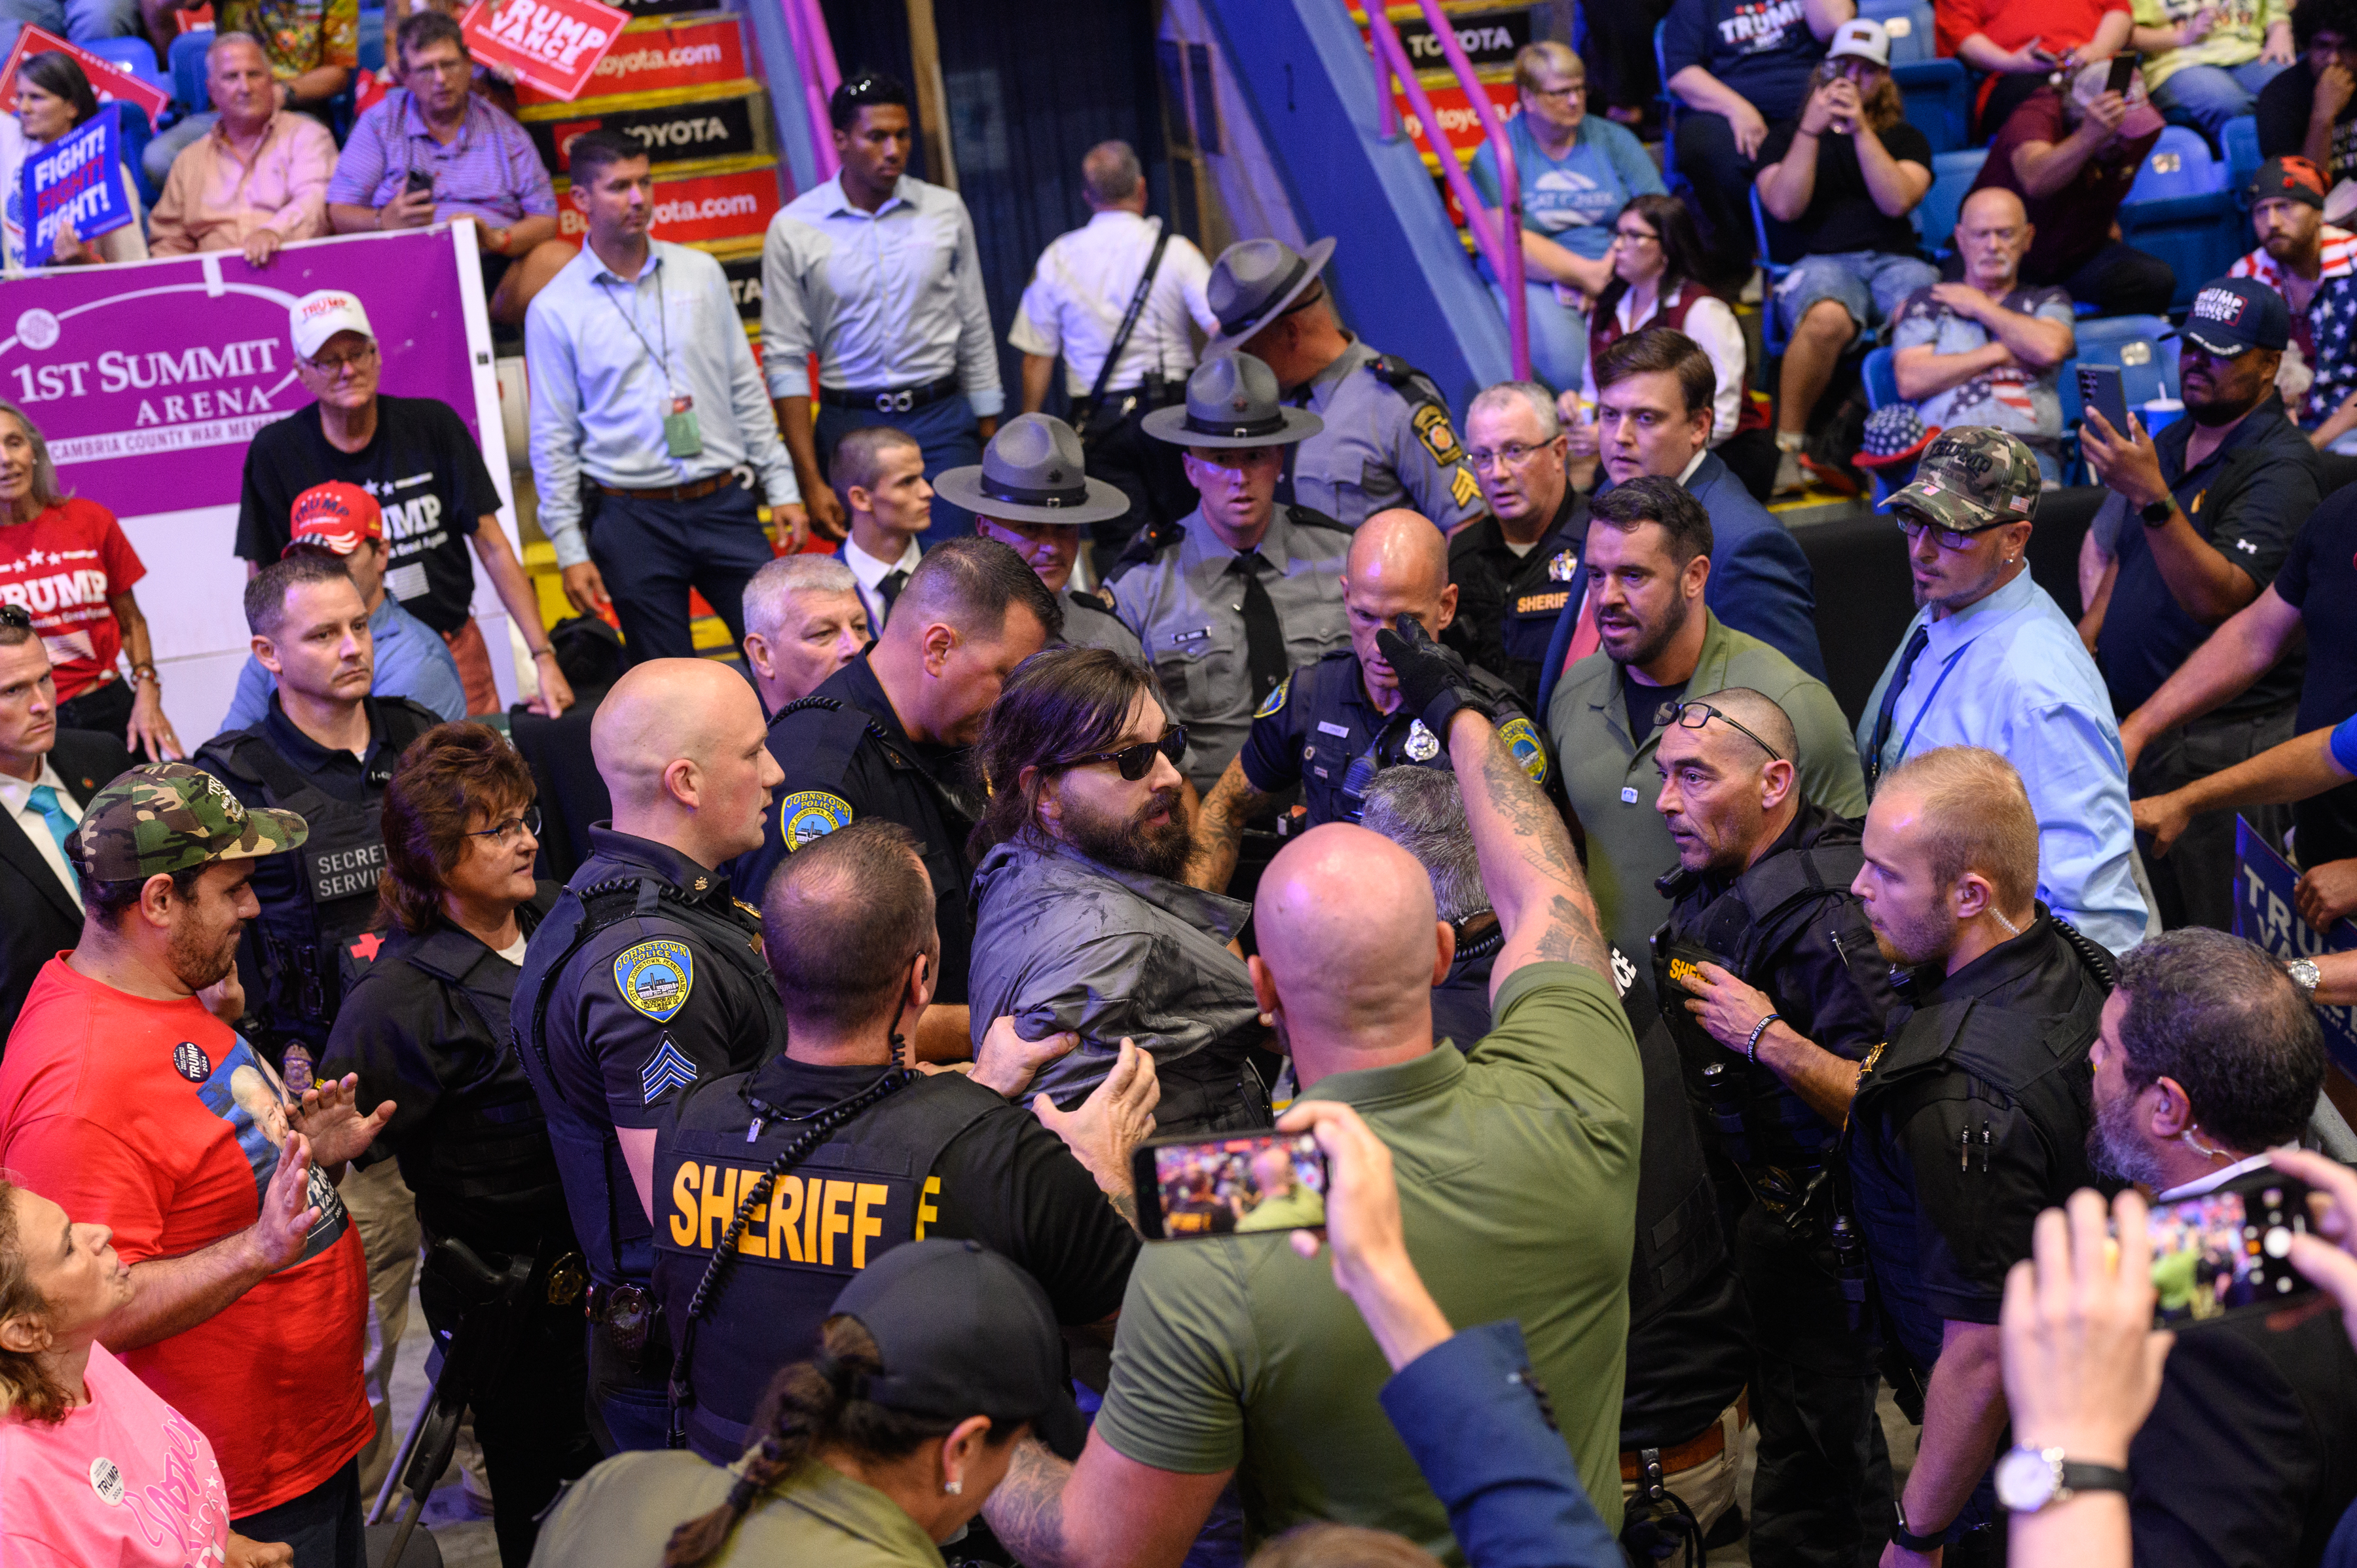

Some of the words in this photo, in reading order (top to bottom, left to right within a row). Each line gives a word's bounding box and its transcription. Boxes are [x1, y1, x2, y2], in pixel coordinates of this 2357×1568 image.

[492, 11, 580, 66] VANCE
[507, 0, 608, 49] RUMP
[1408, 26, 1514, 58] TOOTA
[624, 116, 729, 148] OYOTA
[34, 124, 106, 192] FIGHT!
[37, 155, 105, 218] FIGHT!
[11, 361, 90, 403] 1ST
[136, 385, 272, 426] ARENA
[124, 429, 184, 453] COUNTY
[190, 424, 223, 442] WAR
[0, 569, 108, 614] RUMP
[1517, 592, 1570, 613] SHERIF
[786, 793, 850, 818] JOHNSTOWN
[801, 800, 835, 814] POLICE
[319, 867, 385, 897] SERVIC
[618, 943, 687, 970] JOHNSTOWN
[632, 950, 672, 966] POLICE
[629, 989, 638, 1001] CITY
[663, 959, 685, 993] PENNSYLVANIA
[641, 996, 680, 1006] INCORPORATED
[1751, 1017, 1770, 1040] MATTER
[187, 1043, 200, 1078] TRUMP
[669, 1161, 888, 1269] SHERIFF
[98, 1466, 119, 1495] TRUMP
[113, 1487, 122, 1499] 2024
[189, 1491, 219, 1538] FOR
